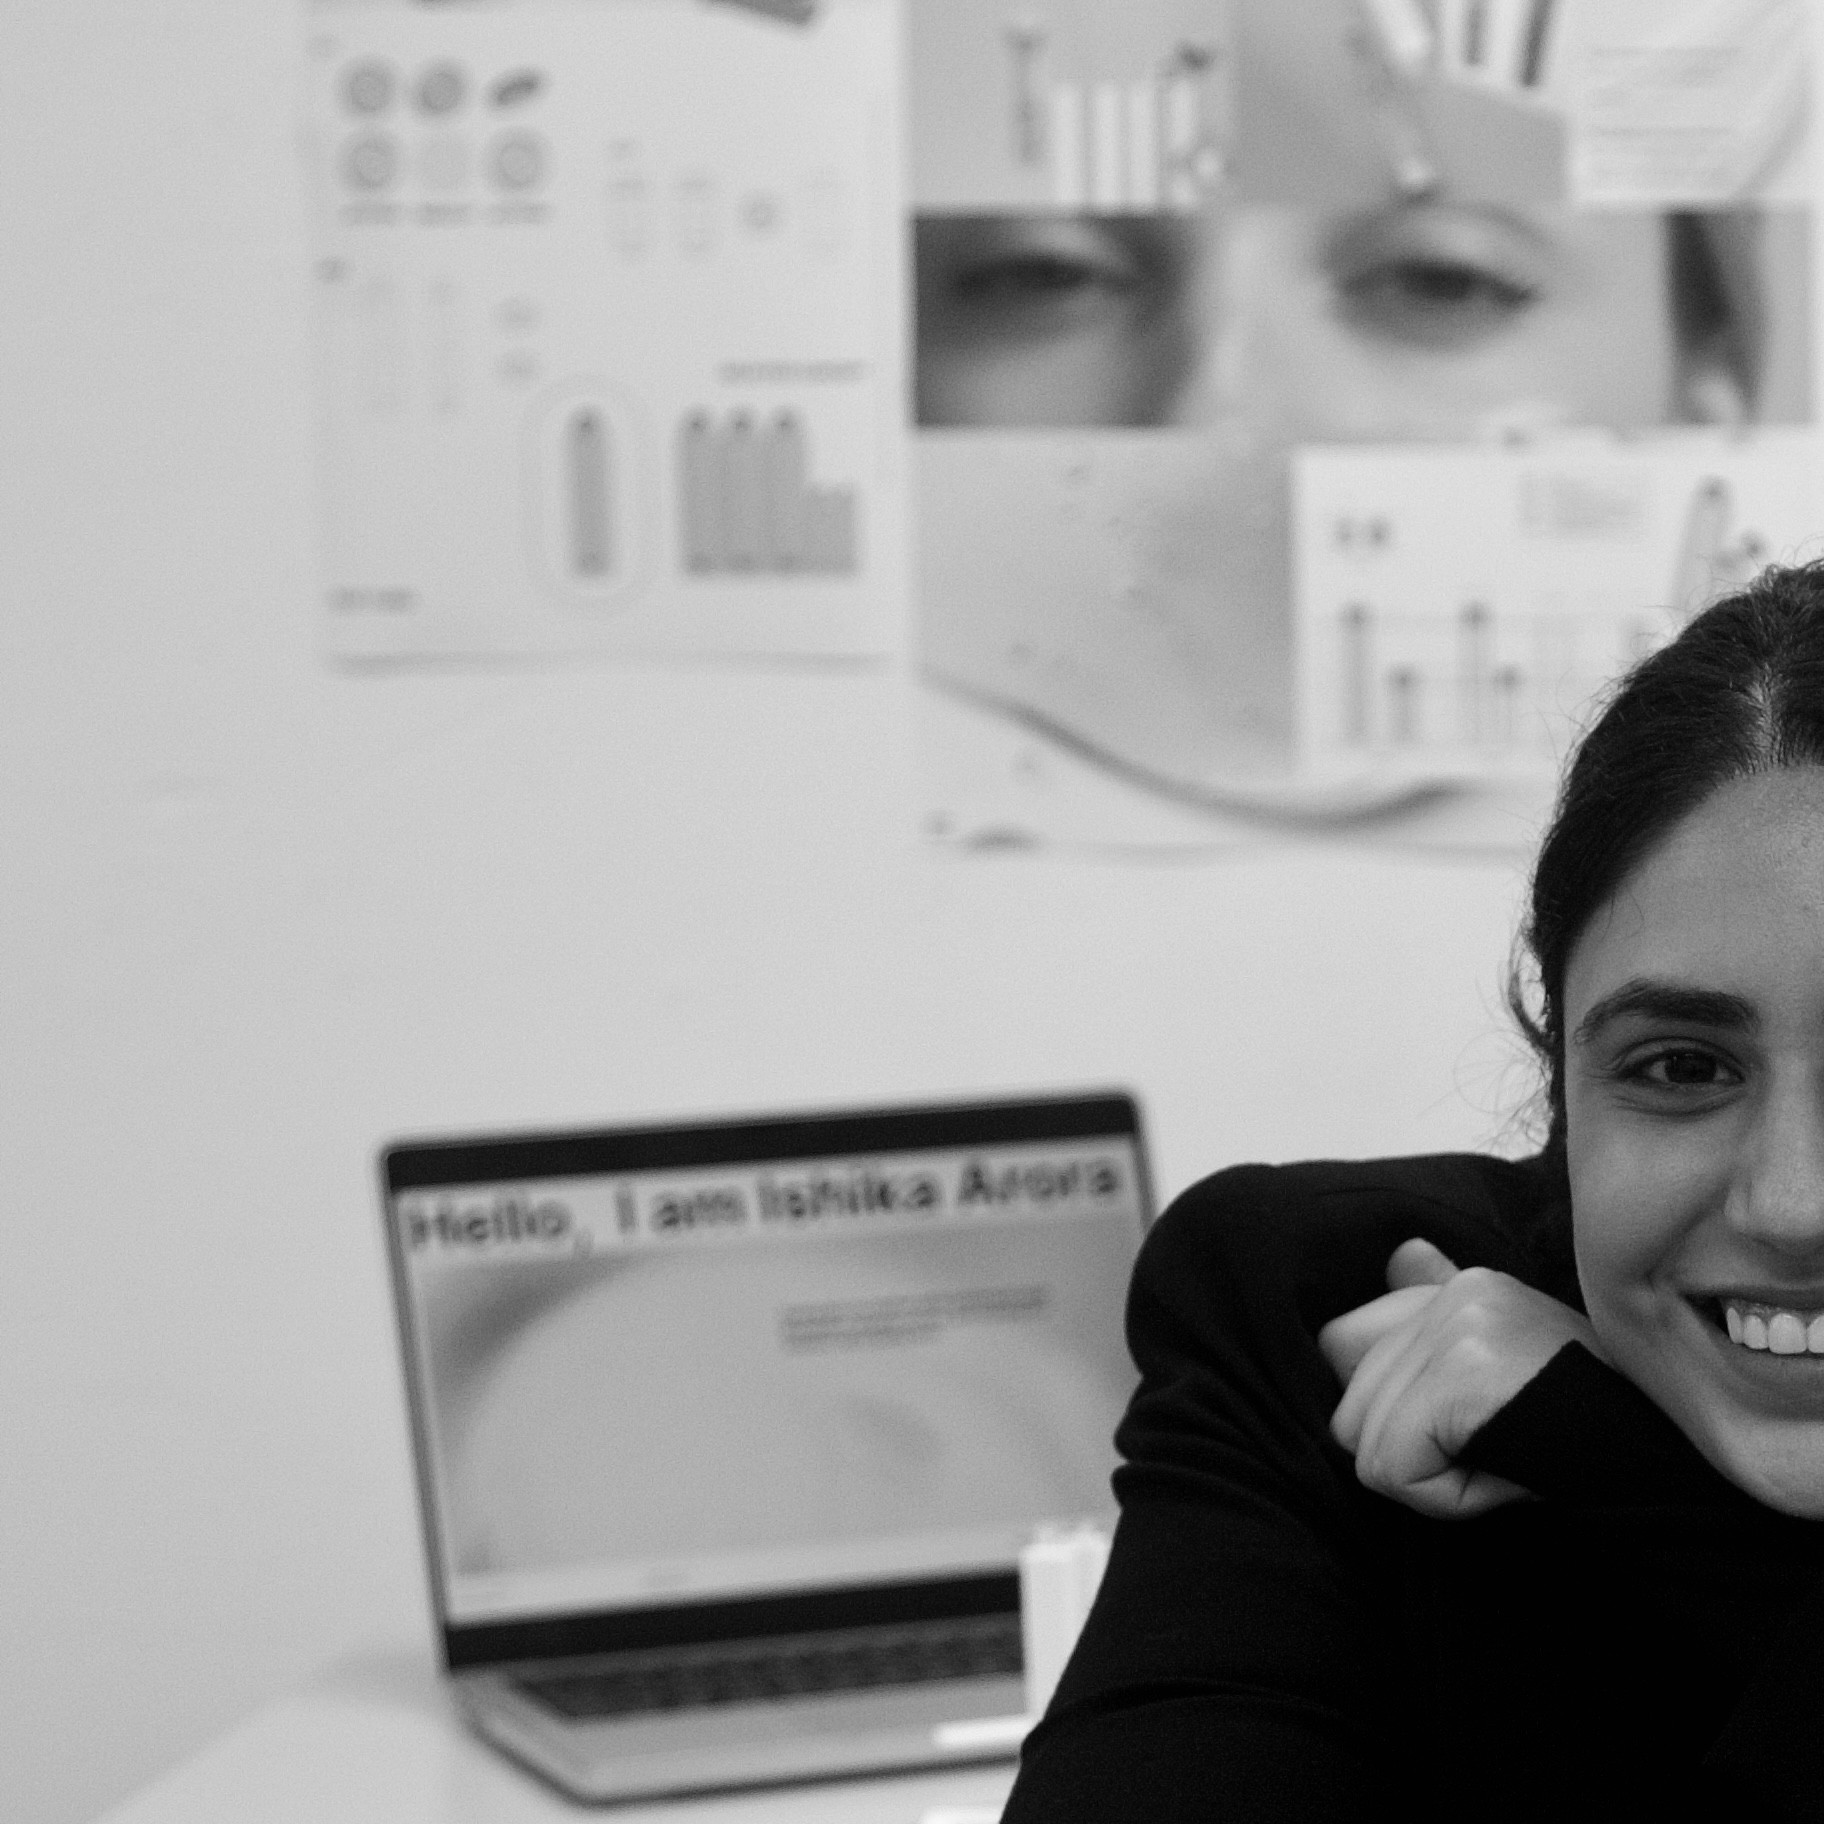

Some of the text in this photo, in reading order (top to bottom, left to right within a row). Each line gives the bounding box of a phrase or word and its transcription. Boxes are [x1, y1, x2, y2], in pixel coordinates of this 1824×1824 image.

[408, 1150, 1125, 1256] Hello, I am Ishika Arora
